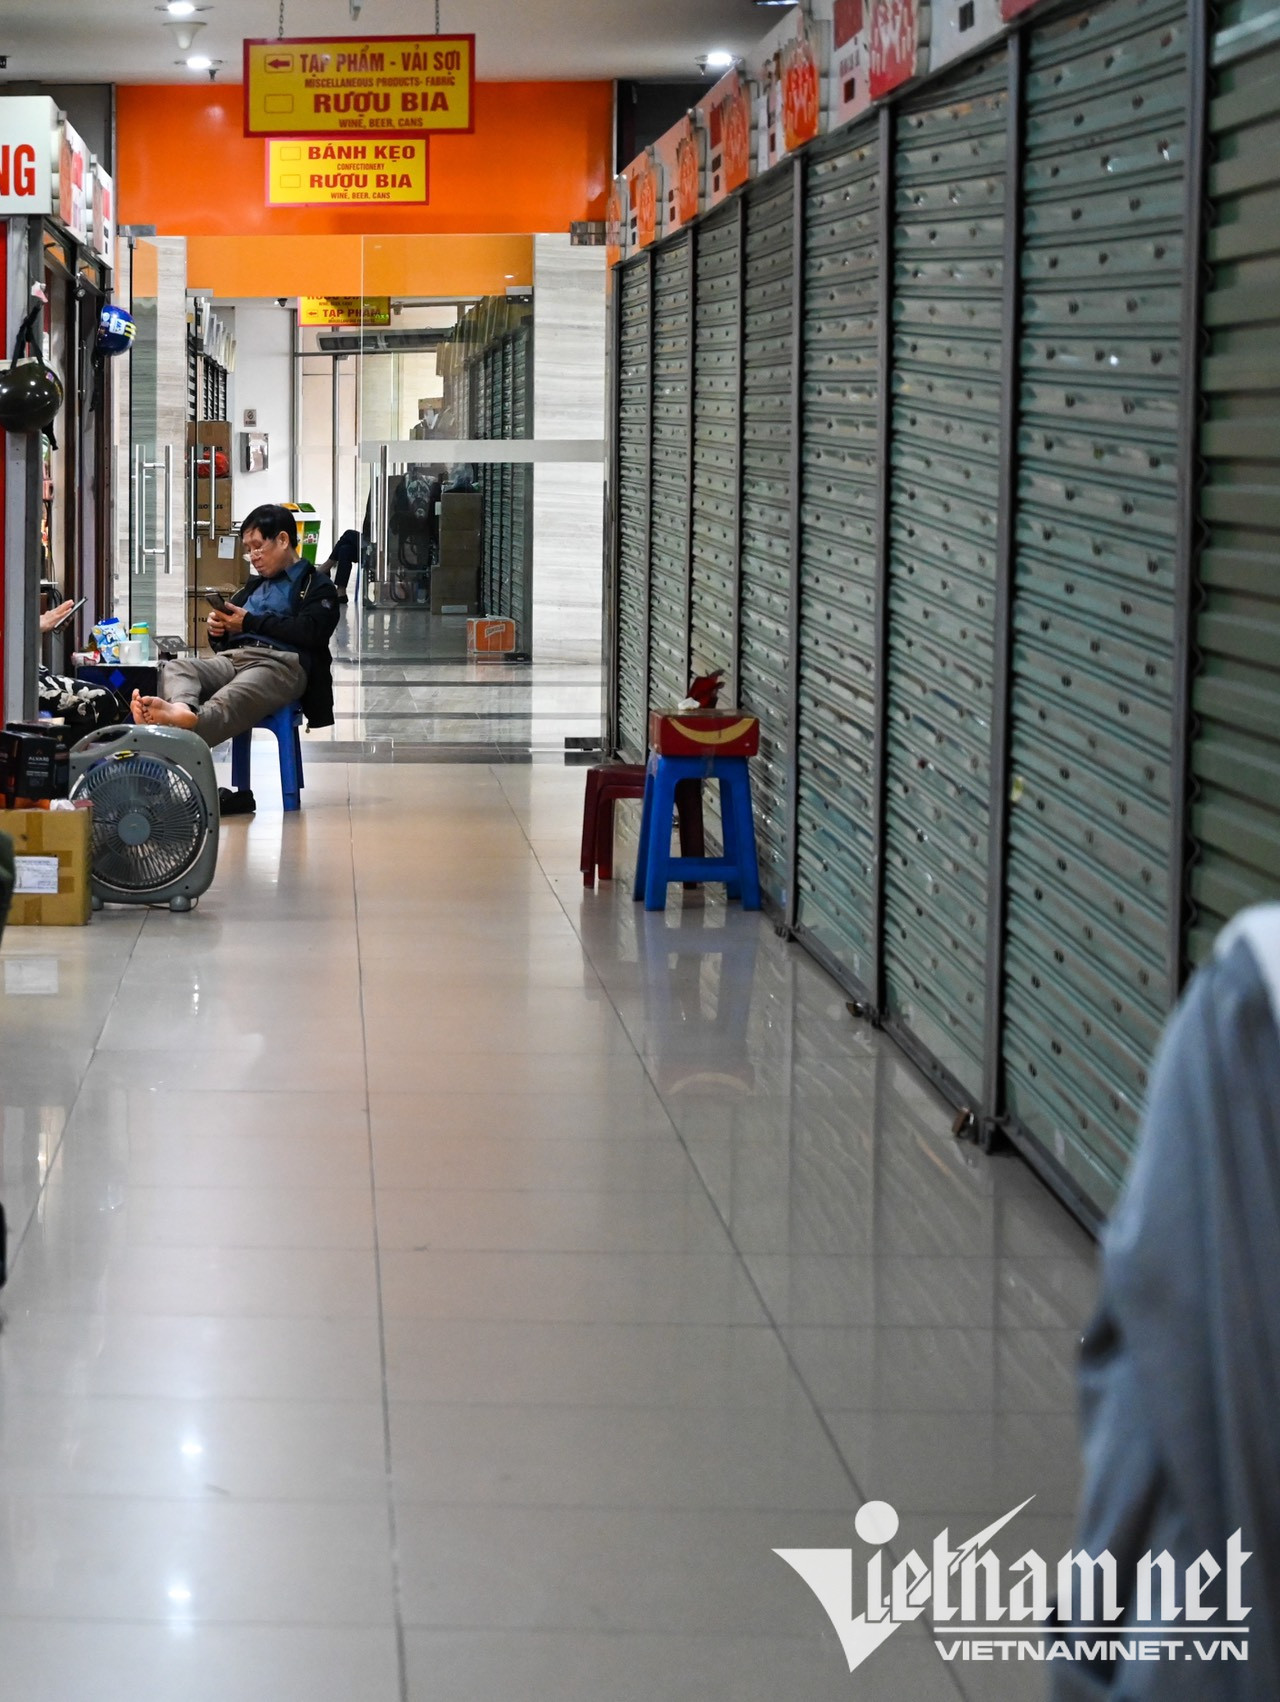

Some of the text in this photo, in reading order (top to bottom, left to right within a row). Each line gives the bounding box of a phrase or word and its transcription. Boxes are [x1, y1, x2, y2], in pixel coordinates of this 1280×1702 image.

[401, 44, 427, 71] VẢI
[433, 50, 460, 75] SỢI
[314, 91, 449, 117] RƯỢU BIA
[398, 118, 423, 127] CANS
[308, 143, 415, 162] BÁNH KẸO
[337, 163, 385, 171] CONFECTIONERY
[310, 173, 412, 191] RƯỢU BIA
